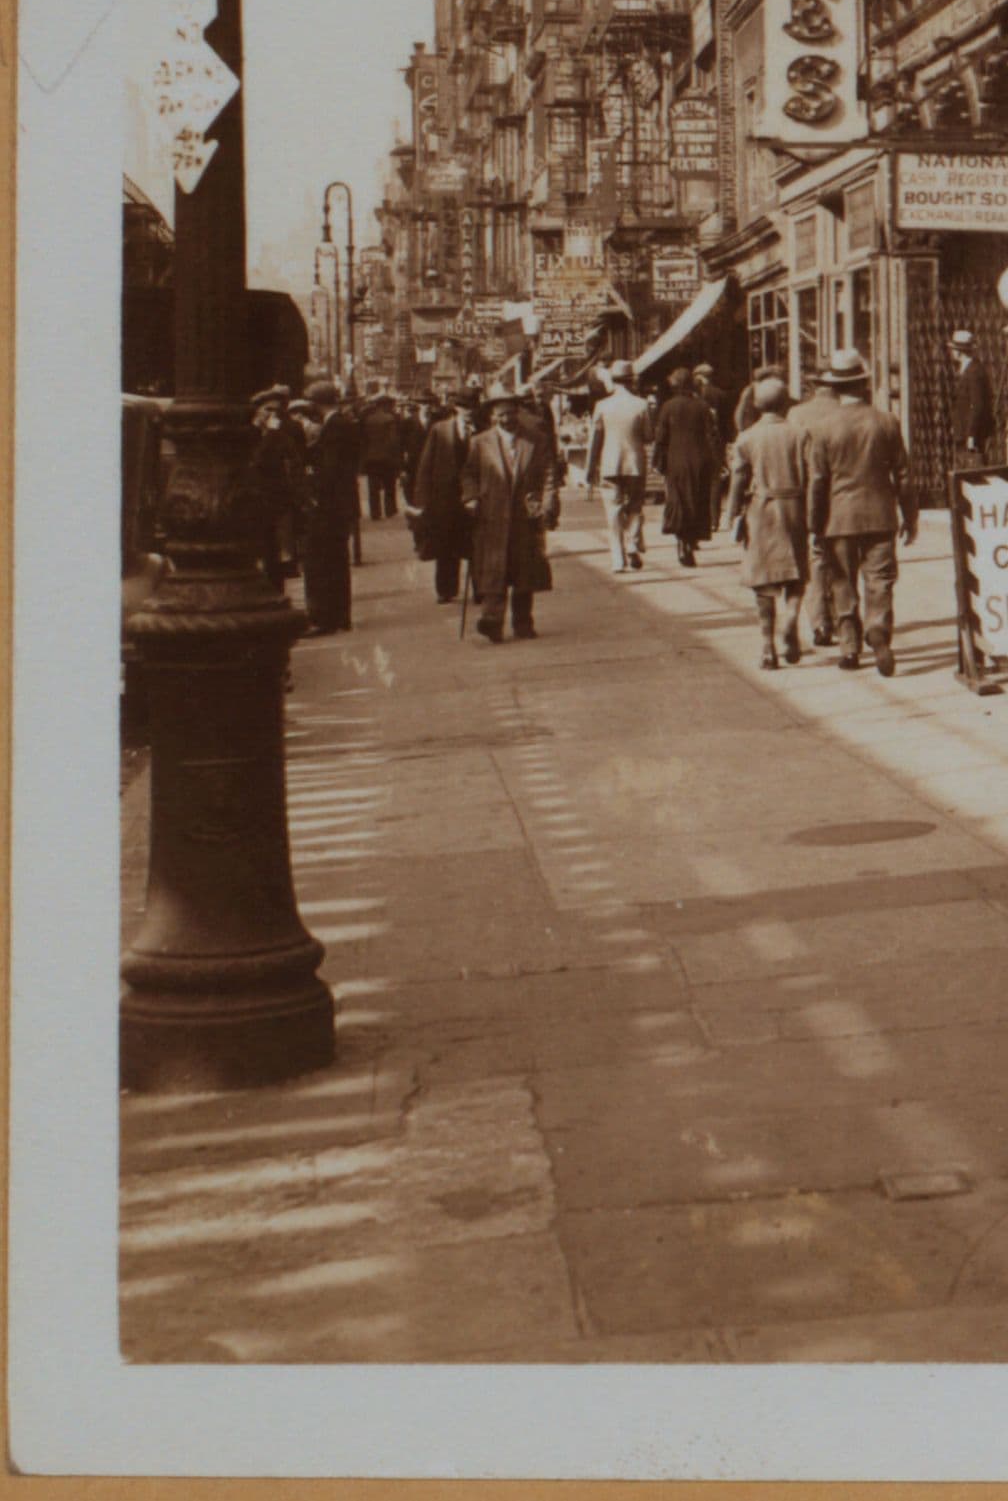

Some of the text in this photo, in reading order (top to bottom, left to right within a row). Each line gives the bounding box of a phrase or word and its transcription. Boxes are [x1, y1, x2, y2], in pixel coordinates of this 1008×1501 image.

[904, 191, 977, 206] BOUGHT
[443, 321, 491, 337] HOTEL
[543, 331, 585, 346] BARS
